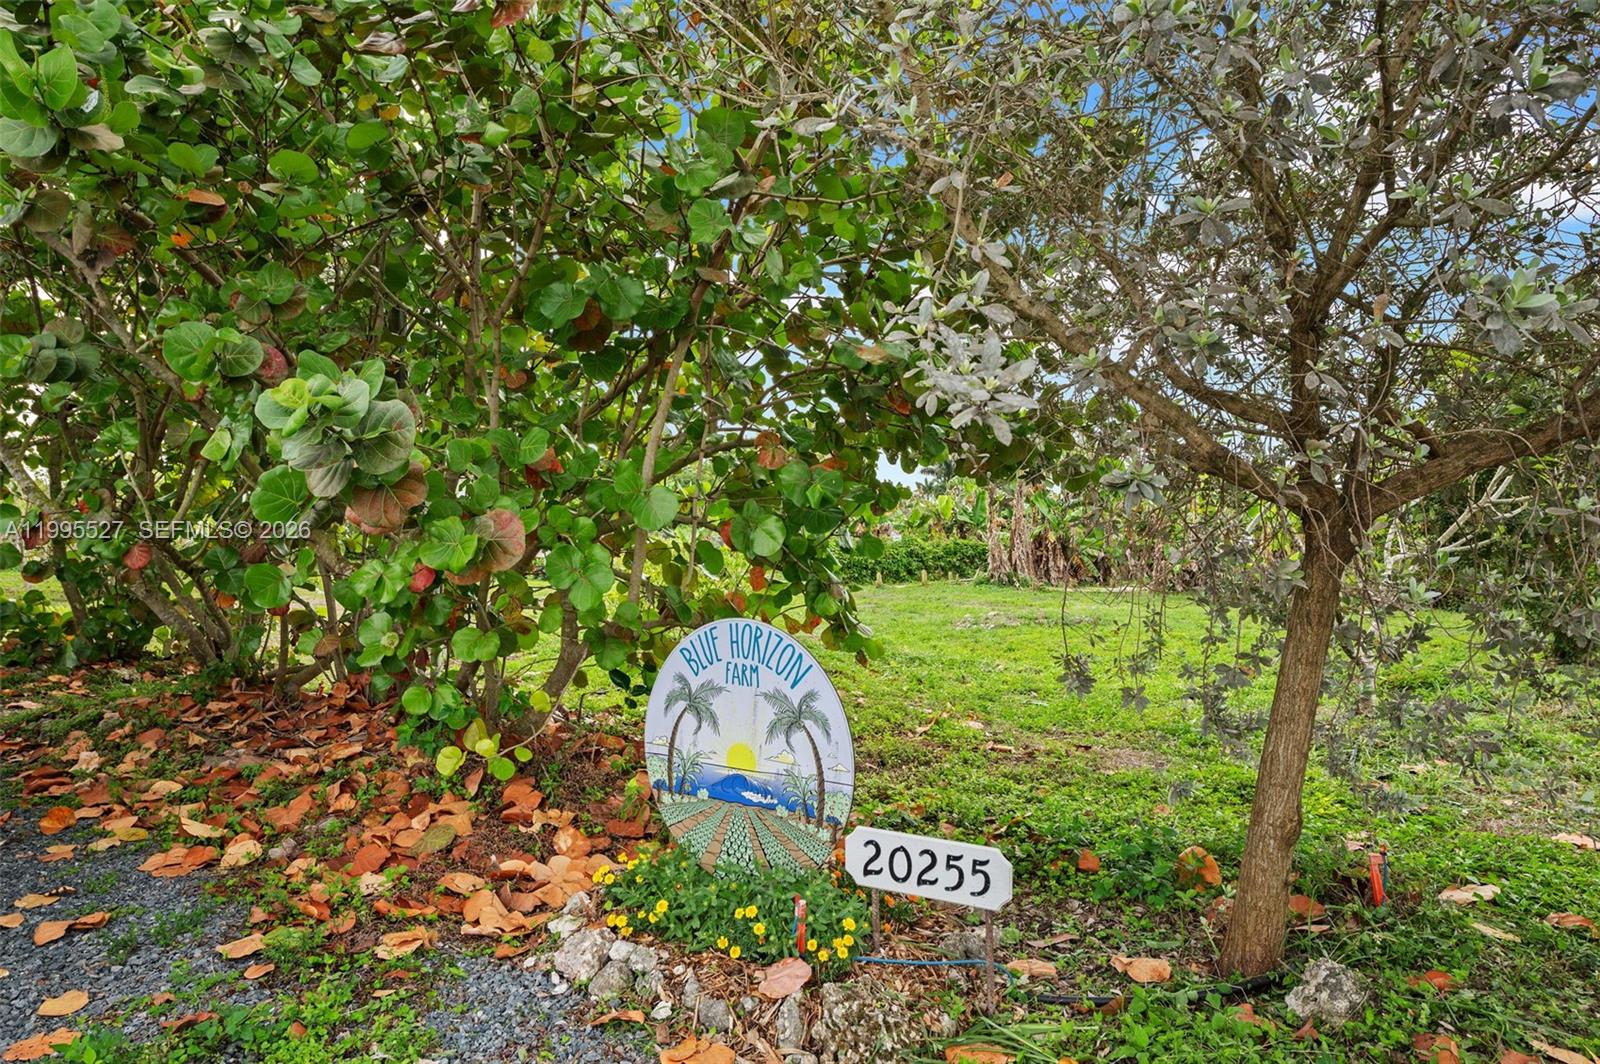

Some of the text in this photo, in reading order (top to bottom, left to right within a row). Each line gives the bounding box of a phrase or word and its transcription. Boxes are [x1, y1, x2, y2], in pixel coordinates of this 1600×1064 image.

[679, 623, 813, 690] BLUE HORIZON
[725, 661, 760, 688] FARM
[863, 839, 991, 897] 20255
